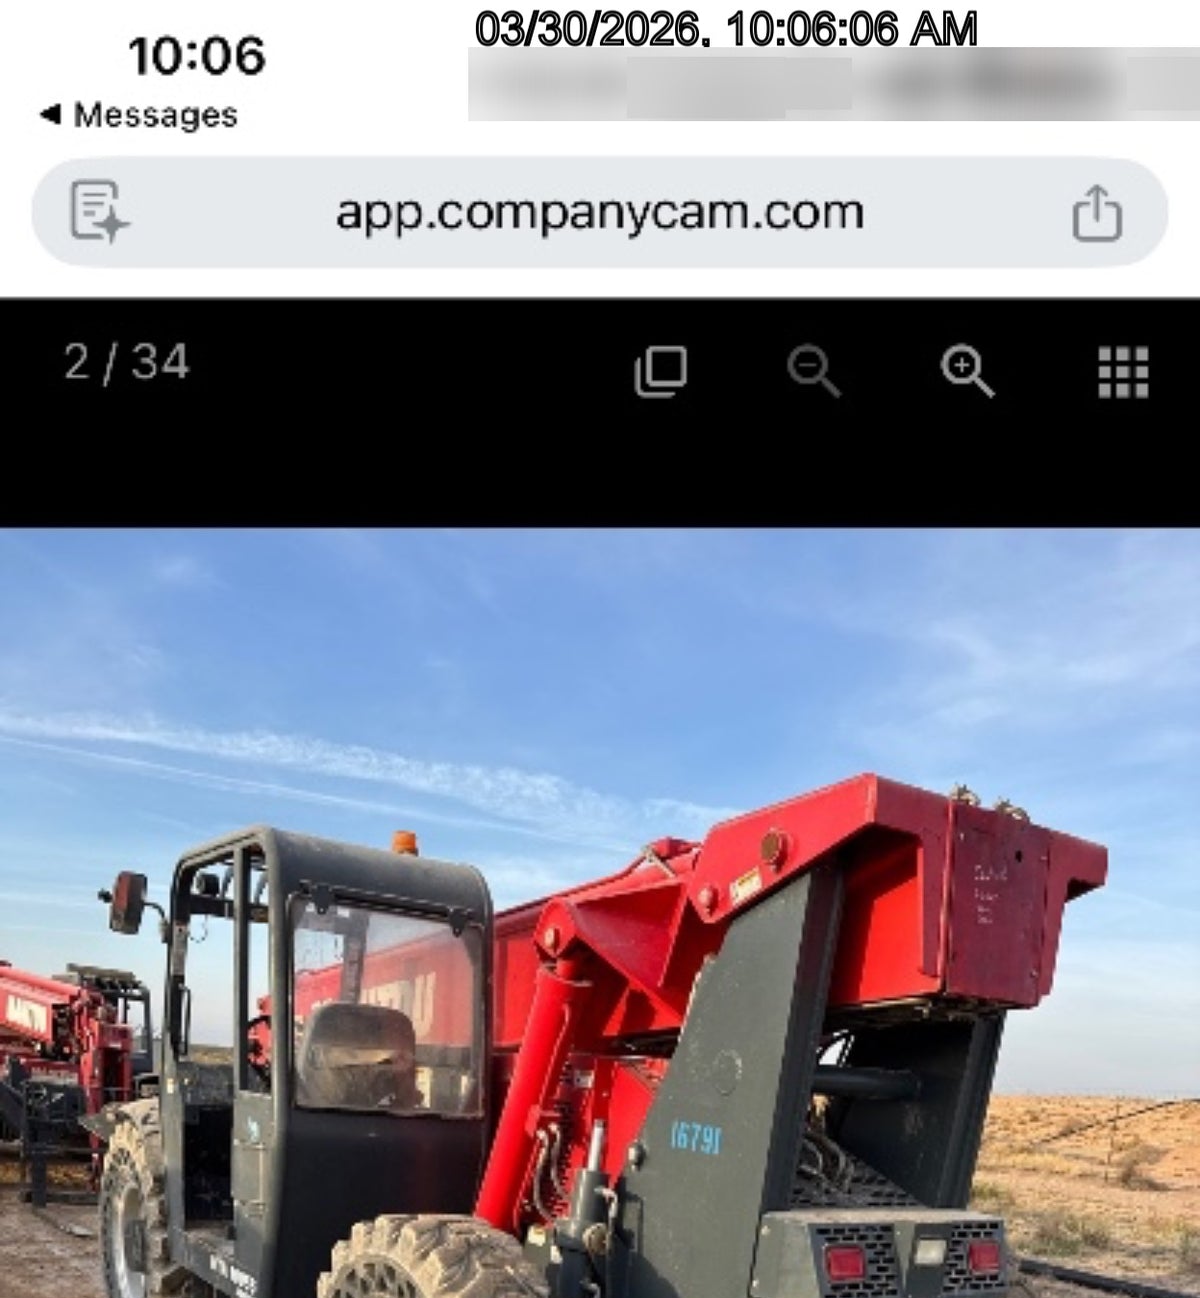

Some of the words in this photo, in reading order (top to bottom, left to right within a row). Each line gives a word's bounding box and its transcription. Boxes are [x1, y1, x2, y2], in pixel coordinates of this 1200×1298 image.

[129, 35, 266, 76] 10:06
[75, 101, 238, 134] Messages
[336, 198, 864, 240] app.companycam.com
[64, 342, 88, 382] 2
[132, 342, 189, 382] 34
[670, 1120, 722, 1155] 16791
